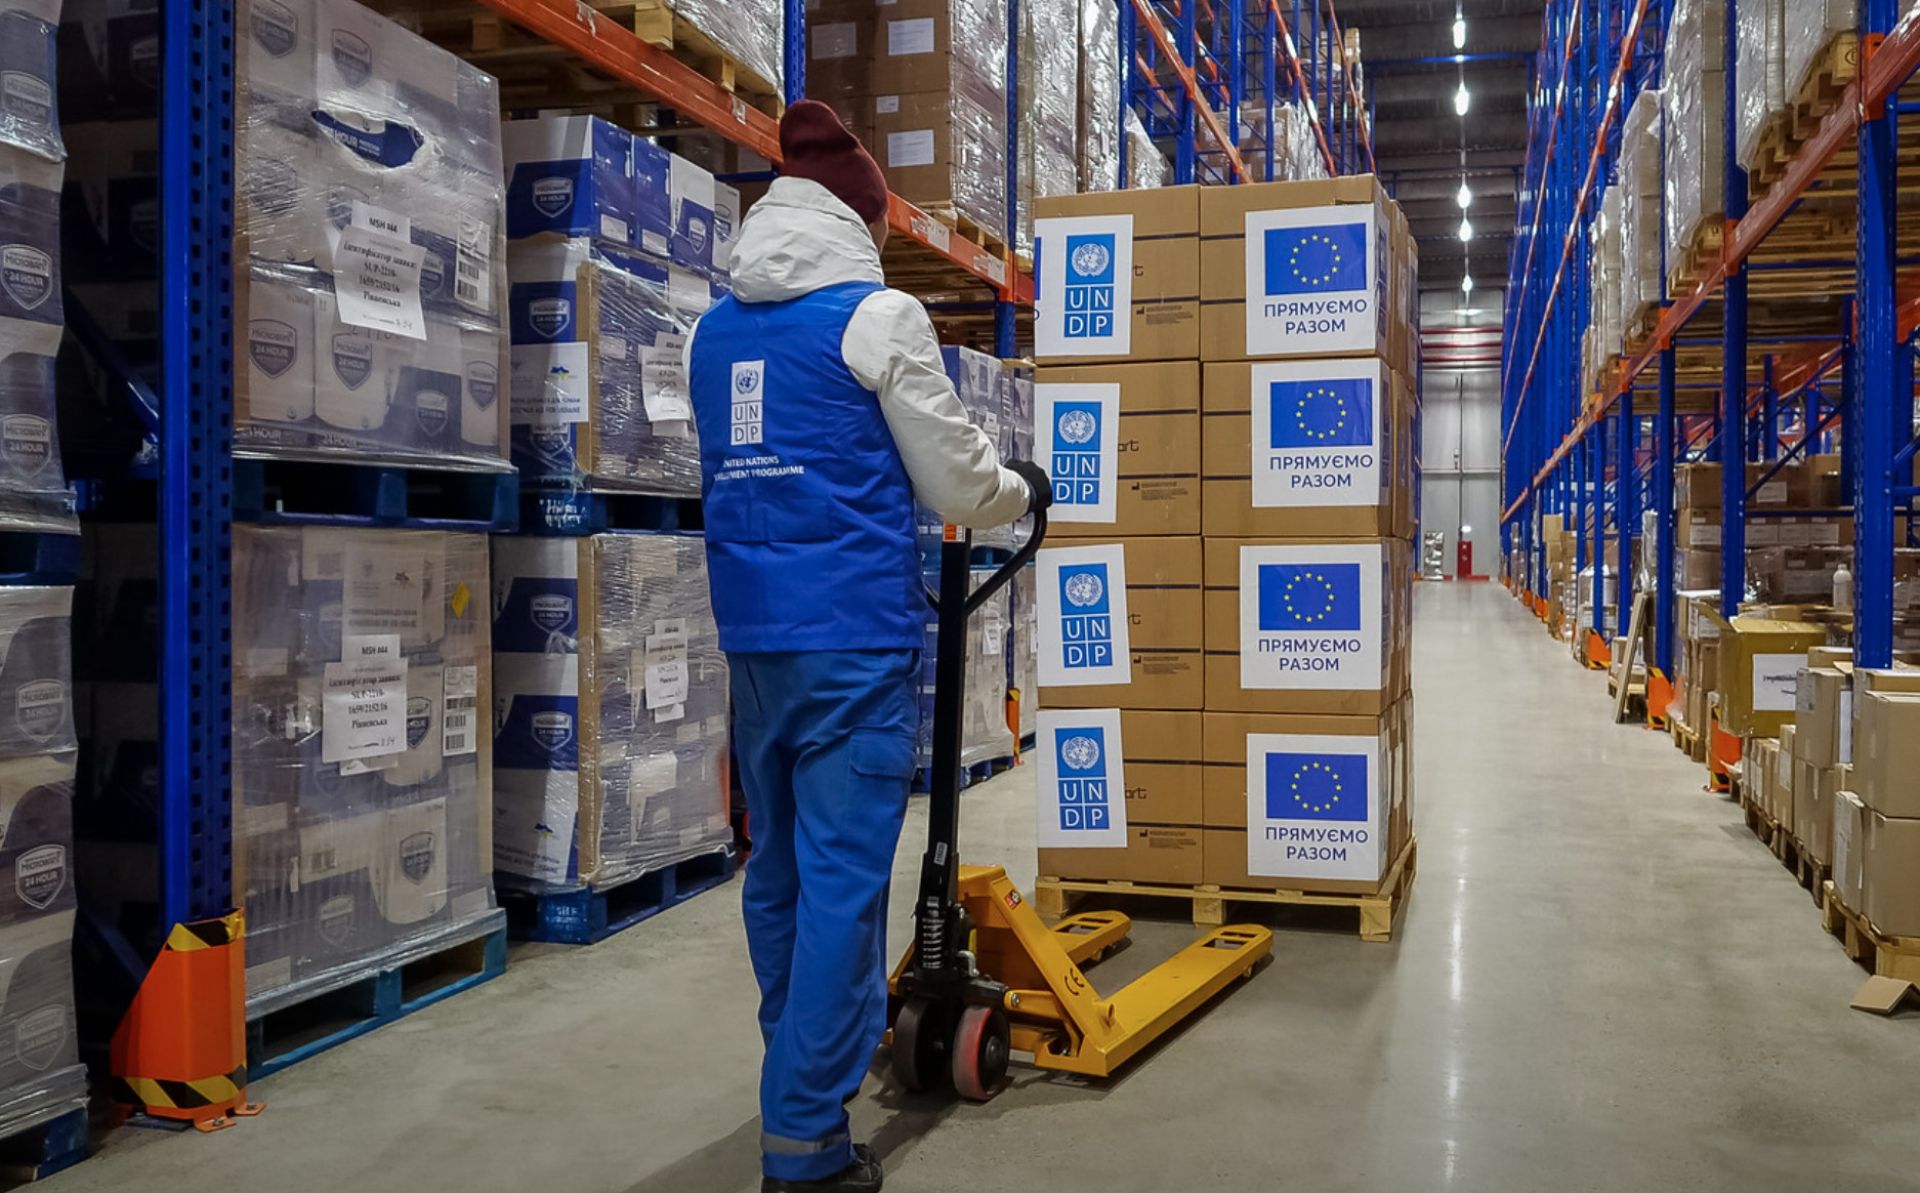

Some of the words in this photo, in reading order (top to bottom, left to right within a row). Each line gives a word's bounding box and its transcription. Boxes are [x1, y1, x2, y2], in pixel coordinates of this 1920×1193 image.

[1070, 289, 1109, 309] UN
[1264, 299, 1367, 318] ПРЯМУЄМО
[1069, 315, 1108, 335] DP
[1285, 319, 1345, 335] РАЗОМ
[734, 404, 758, 421] UN
[734, 425, 758, 442] DP
[723, 458, 745, 468] NITED
[746, 455, 779, 467] NATIONS
[1056, 456, 1096, 475] UN
[1270, 454, 1373, 470] ПРЯМУЄМО
[751, 465, 805, 477] PROGRAMME
[1291, 473, 1352, 489] РАЗОМ
[1056, 482, 1094, 502] DP
[1066, 619, 1106, 639] UN
[1258, 638, 1361, 653] ПРЯМУЄМО
[1068, 645, 1106, 665] DP
[1279, 657, 1340, 671] РАЗОМ
[1063, 782, 1103, 801] UN
[1065, 808, 1103, 827] DP
[1265, 827, 1368, 844] ПРЯМУЄМО
[1286, 846, 1347, 862] РАЗОМ
